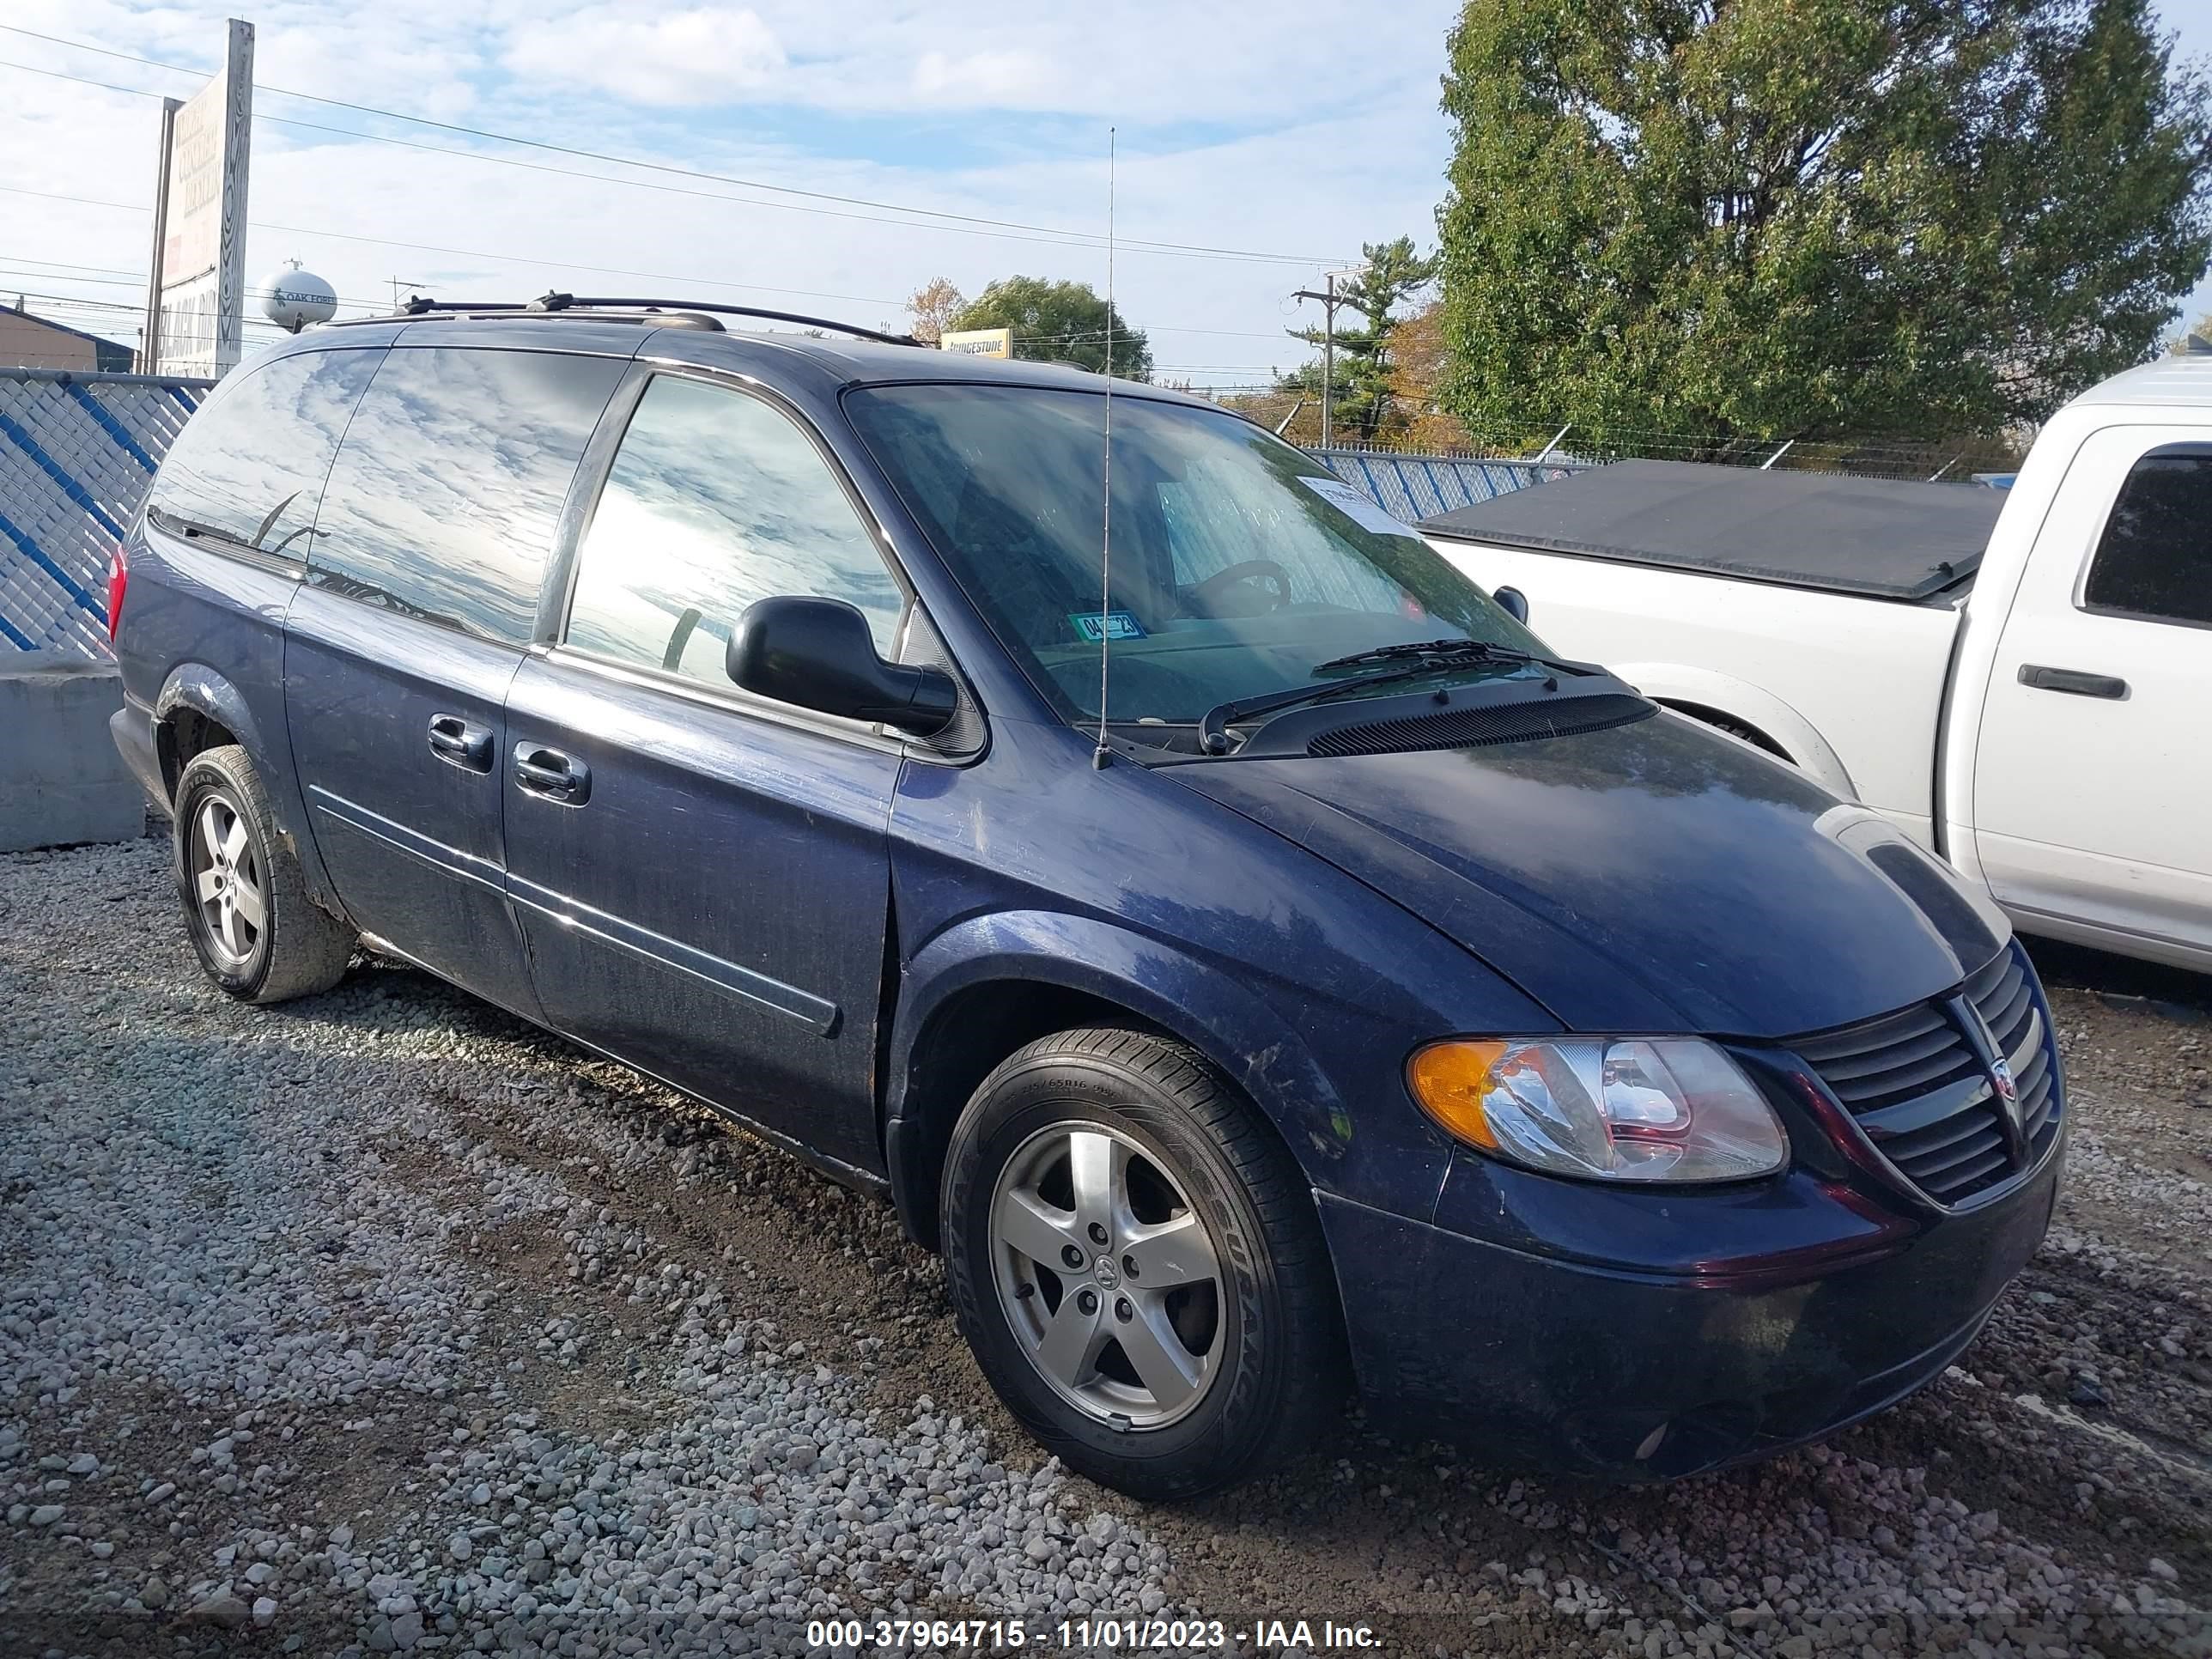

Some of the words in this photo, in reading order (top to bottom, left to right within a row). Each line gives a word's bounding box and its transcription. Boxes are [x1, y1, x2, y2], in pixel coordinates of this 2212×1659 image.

[287, 293, 310, 302] OAK
[157, 296, 196, 360] BLACK
[947, 340, 1004, 355] BRIDGESTONE
[1084, 618, 1104, 636] 04
[1116, 617, 1136, 634] 23
